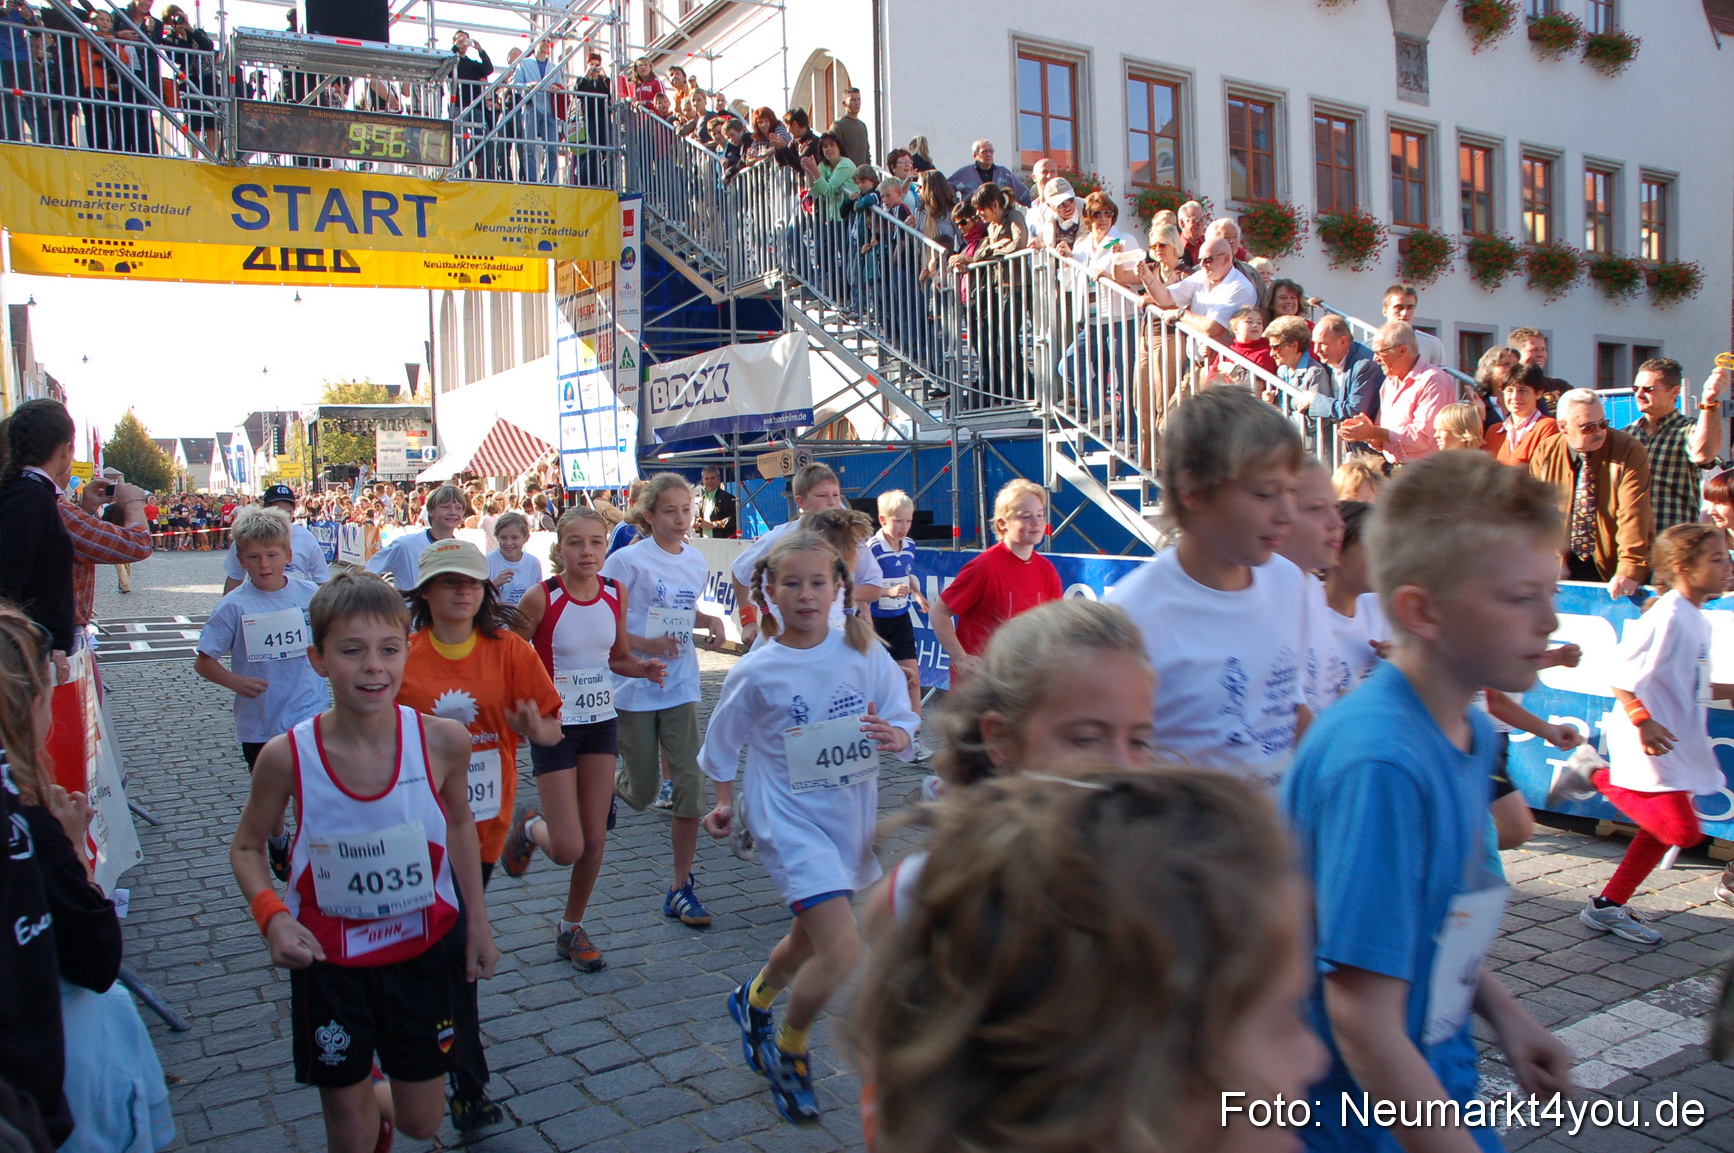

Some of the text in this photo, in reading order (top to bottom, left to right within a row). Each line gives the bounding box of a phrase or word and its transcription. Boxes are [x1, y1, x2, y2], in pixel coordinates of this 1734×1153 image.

[308, 109, 356, 122] Elektronische
[39, 195, 193, 216] Neumarkter Stadtlauf
[230, 183, 438, 238] START
[473, 222, 590, 238] Neumarkter Stadtlauf
[651, 363, 731, 414] BOCK
[703, 570, 737, 616] Wag
[264, 629, 302, 647] 4151
[575, 690, 611, 709] 4053
[816, 738, 871, 768] 4046
[337, 839, 386, 859] Daniel
[317, 866, 331, 880] Ju
[347, 861, 424, 896] 4035
